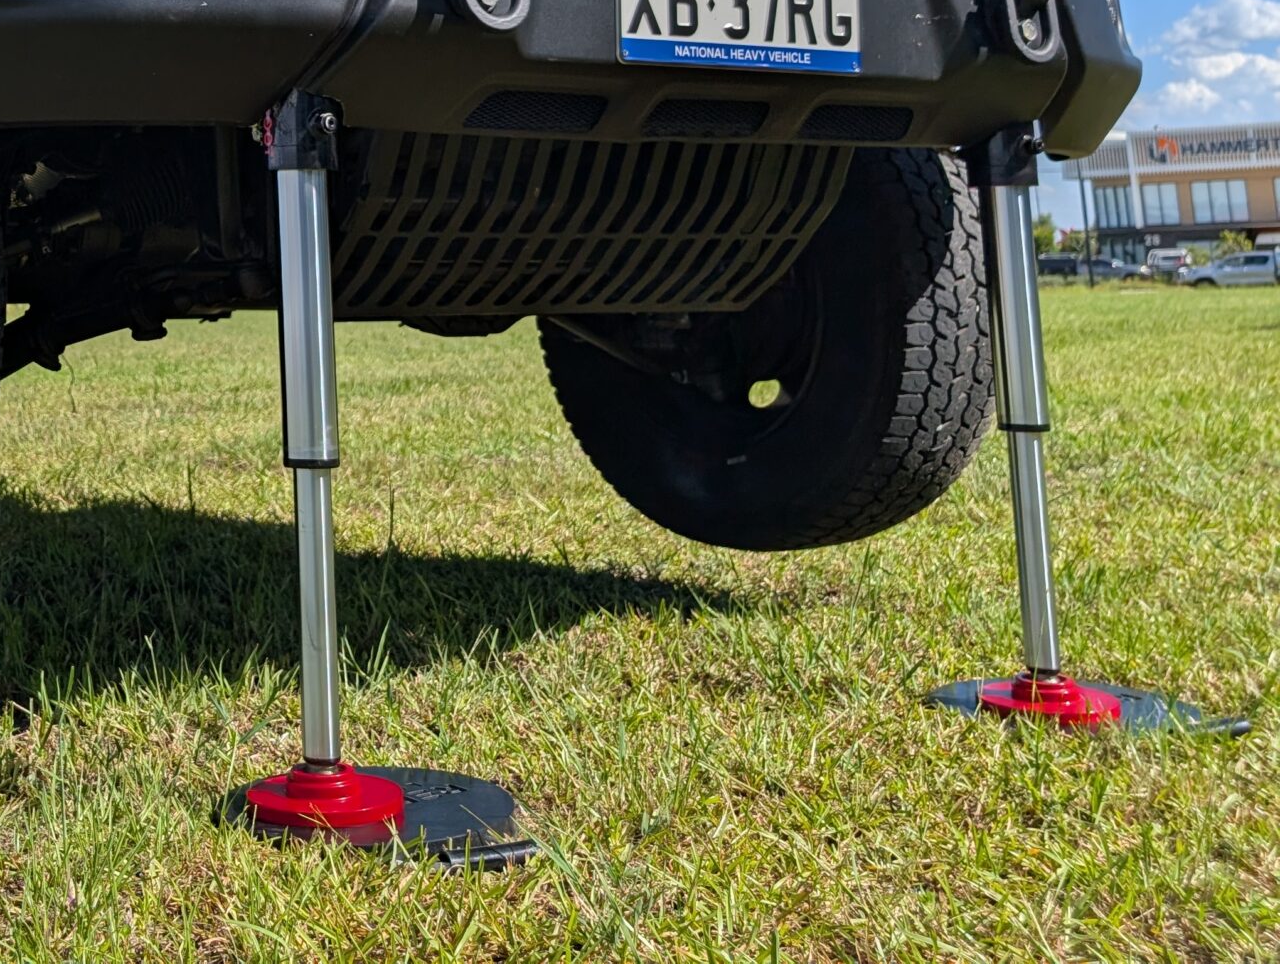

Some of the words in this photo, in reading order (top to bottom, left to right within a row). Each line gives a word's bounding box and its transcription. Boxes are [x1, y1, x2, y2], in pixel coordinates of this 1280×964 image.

[674, 44, 729, 61] NATIONAL
[729, 48, 767, 63] HEAVY
[767, 50, 811, 64] VEHICLE
